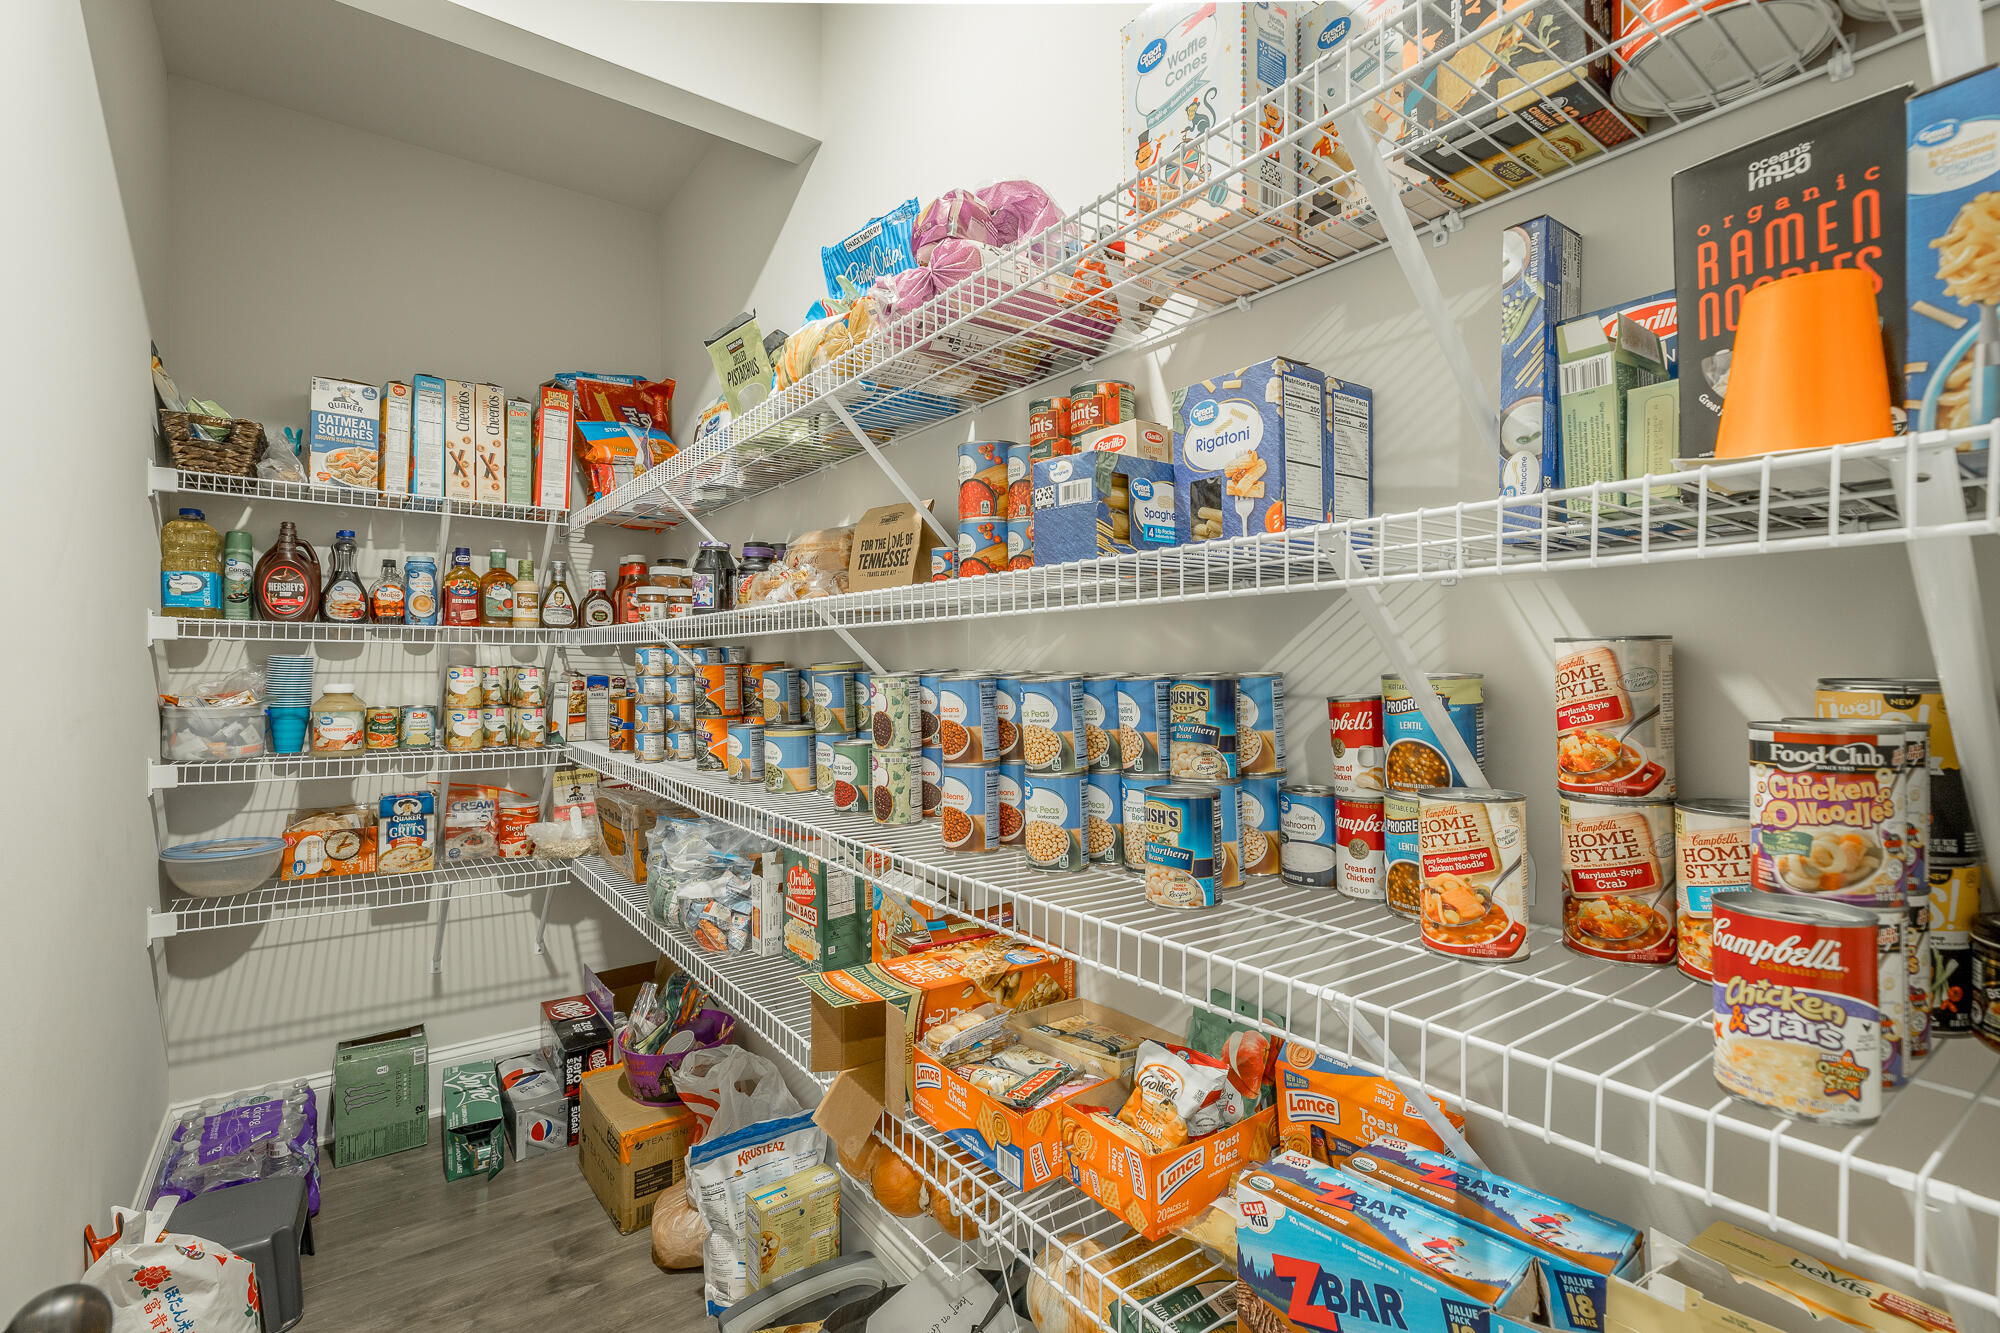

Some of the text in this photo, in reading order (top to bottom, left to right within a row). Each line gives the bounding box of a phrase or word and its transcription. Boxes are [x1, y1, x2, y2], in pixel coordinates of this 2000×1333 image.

[1321, 20, 1345, 43] Great
[1140, 42, 1162, 65] Great
[1167, 35, 1207, 70] Waffle
[1165, 52, 1207, 87] Cones
[1748, 140, 1815, 171] ocean's
[1697, 165, 1880, 238] organic
[845, 225, 881, 250] SNACK FACTORY
[1697, 189, 1880, 290] RAMEN
[1284, 375, 1320, 392] Nutrition Facts
[543, 398, 570, 411] Charms
[546, 390, 568, 402] Lucky
[1334, 393, 1368, 408] Nutrition Facts
[1698, 393, 1722, 416] Great
[327, 401, 364, 414] QUAKER
[456, 390, 470, 432] Cheerios
[486, 395, 500, 436] Cheerios
[509, 409, 528, 418] Chex
[1193, 404, 1214, 418] Great
[1285, 400, 1320, 414] Calories 200
[317, 413, 374, 431] OATMEAL
[1077, 418, 1094, 429] SAUCE
[1334, 416, 1368, 429] Calories 200
[315, 434, 355, 445] BROWN SUGAR
[318, 423, 374, 441] SQUARES
[1144, 431, 1163, 443] Barilla
[1196, 426, 1250, 453] Rigatoni
[1096, 434, 1127, 452] Barilla
[1133, 482, 1151, 493] Great
[1144, 507, 1176, 523] Spaghe
[861, 529, 913, 553] FOR THE LOVE OF
[1148, 527, 1155, 538] 4
[858, 548, 912, 570] TENNESSEE
[268, 582, 305, 592] HERSHEY'S
[1558, 701, 1610, 719] Maryland-Style
[1891, 698, 1915, 706] NEW
[1031, 710, 1049, 718] Peas
[1569, 713, 1595, 725] Crab
[1178, 724, 1216, 736] Northern
[1399, 721, 1423, 730] LENTIL
[1769, 742, 1885, 767] Food Club
[567, 773, 594, 783] VALUE PACK
[1768, 772, 1878, 801] Chicken
[452, 800, 494, 812] CREAM
[1039, 806, 1059, 814] Peas
[1425, 805, 1458, 819] Campbell's
[1799, 798, 1894, 829] Noodles
[392, 813, 422, 823] QUAKER
[1146, 810, 1179, 827] USH'S
[1387, 820, 1418, 832] PROGRE
[1420, 815, 1476, 834] HOME
[1576, 820, 1617, 833] Campbell's
[389, 825, 425, 838] GRITS
[505, 824, 523, 832] Steel
[1421, 829, 1480, 849] STYLE
[1568, 829, 1637, 848] HOME
[1691, 833, 1740, 848] Campbell's
[1149, 855, 1164, 863] Beans
[1150, 845, 1190, 860] Northern
[1436, 851, 1487, 864] Southwest-Style
[1570, 844, 1641, 863] STYLE
[1344, 863, 1376, 874] Cream of
[1428, 861, 1484, 873] Chicken Noodle
[1578, 868, 1643, 880] Maryland-Style
[790, 870, 812, 886] Orville
[1346, 873, 1375, 883] Chicken
[1596, 879, 1627, 889] Crab
[787, 899, 816, 922] MINI BAGS
[1713, 916, 1843, 972] Campbell's
[1759, 961, 1818, 978] CONDENSED
[1725, 975, 1846, 1027] Chicken
[1729, 1005, 1845, 1050] & Stars
[905, 1031, 913, 1065] 48 BARS
[573, 1056, 582, 1083] zero
[916, 1064, 942, 1084] Lance
[1816, 1062, 1870, 1081] Original
[457, 1073, 492, 1100] Sprite
[520, 1079, 550, 1094] pepsi
[946, 1075, 968, 1098] Toast
[1141, 1075, 1178, 1100] Goldfish
[1824, 1074, 1860, 1091] Star
[1289, 1093, 1335, 1115] Lance
[1374, 1095, 1394, 1111] Toast
[1359, 1106, 1398, 1136] Toast
[644, 1136, 665, 1147] TEA
[1213, 1132, 1241, 1153] Toast
[738, 1142, 785, 1167] KRUSTEAZ
[1286, 1155, 1311, 1165] CLIF
[1031, 1146, 1048, 1181] Lance
[1130, 1150, 1143, 1197] Lance
[1160, 1150, 1202, 1195] Lance
[1091, 1171, 1099, 1196] Lance
[1378, 1169, 1456, 1205] CHOCOLATE BROWNIE
[1157, 1203, 1182, 1223] 20 PACKS
[1242, 1202, 1265, 1216] CLIF
[1275, 1188, 1350, 1227] CHOCOLATE BROWNIE
[1315, 1229, 1332, 1241] GRAINS
[1342, 1242, 1356, 1253] GOOD
[1357, 1249, 1376, 1263] SOURCE
[1385, 1263, 1399, 1274] FIBER
[1410, 1276, 1437, 1293] NON-GMO
[1559, 1274, 1595, 1290] VALUE
[1789, 1257, 1873, 1299] belVita
[1564, 1284, 1586, 1295] PACK
[1447, 1303, 1481, 1321] VALUE
[1567, 1293, 1597, 1320] 18
[1450, 1314, 1471, 1326] PACK
[1572, 1316, 1599, 1329] BARS
